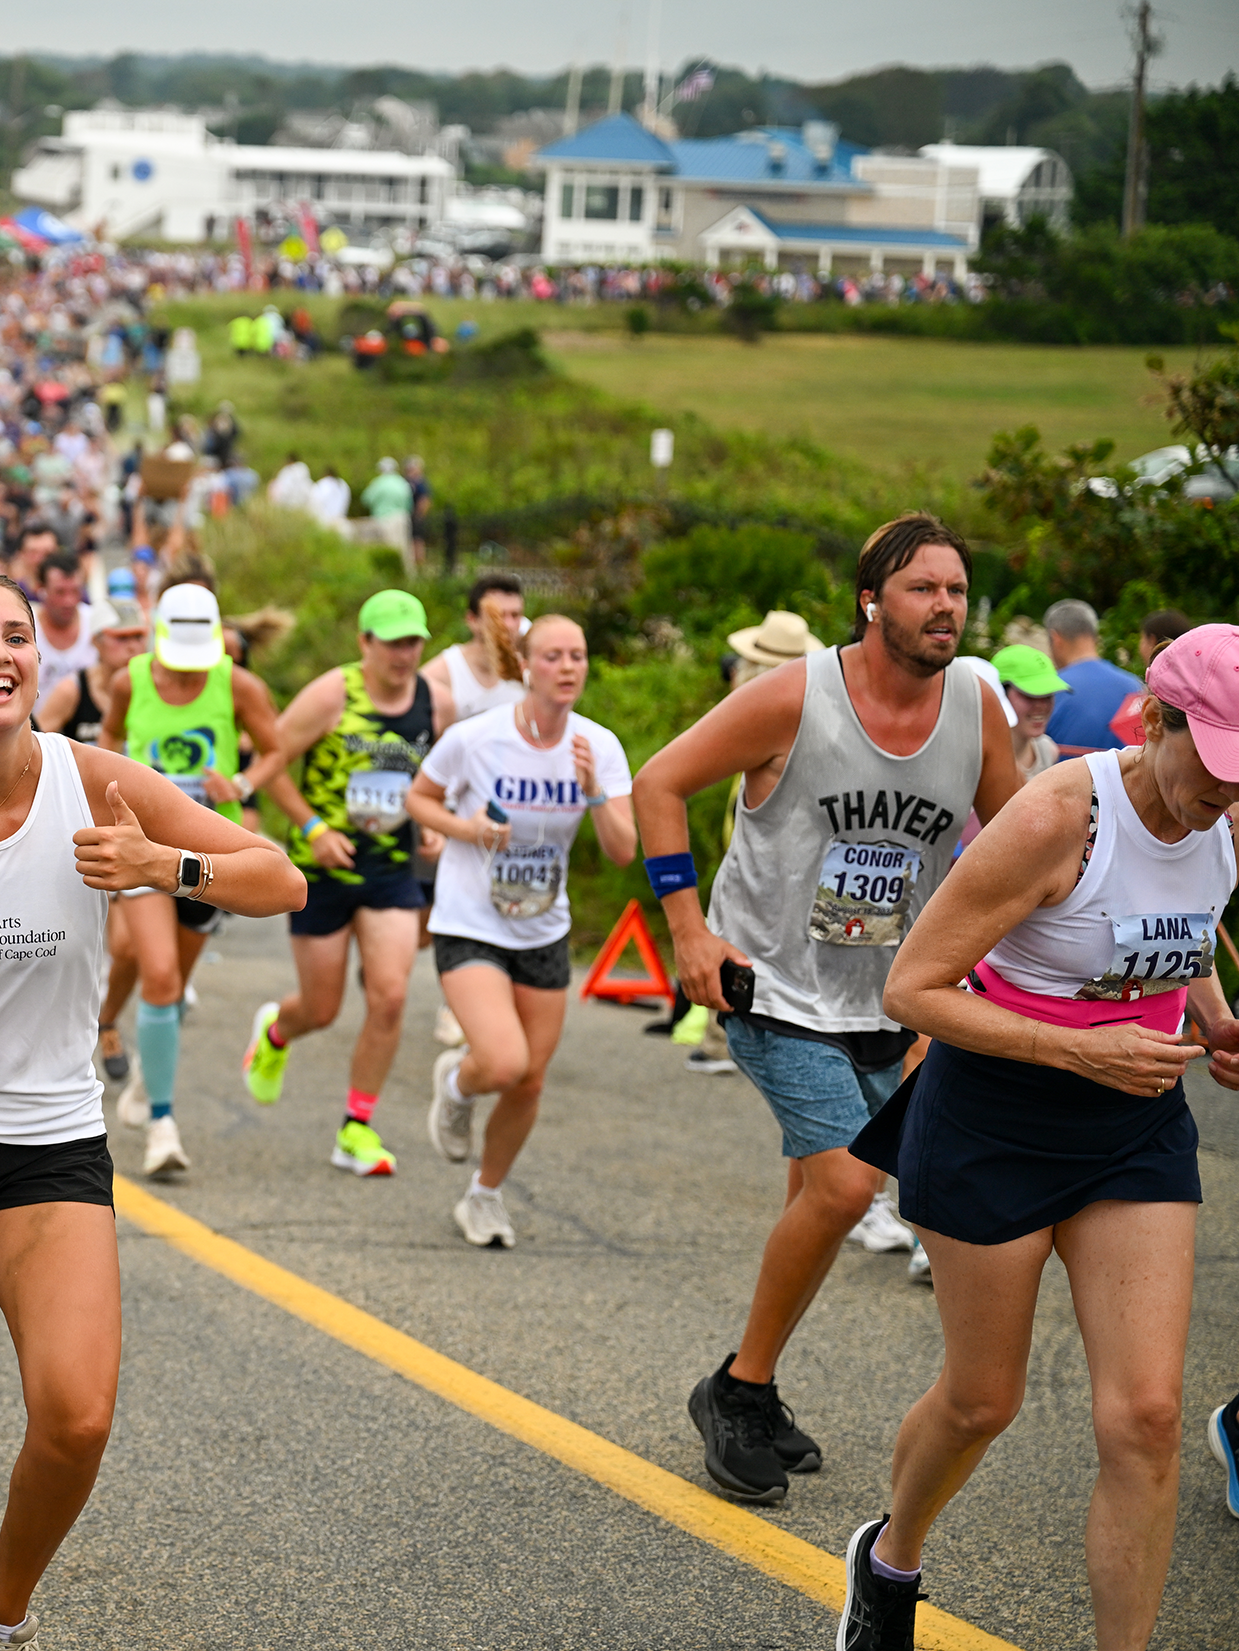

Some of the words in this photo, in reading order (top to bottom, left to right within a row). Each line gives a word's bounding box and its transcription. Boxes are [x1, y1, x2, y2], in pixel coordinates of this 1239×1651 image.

[818, 789, 954, 846] THAYER
[844, 847, 905, 868] CONOR
[834, 871, 904, 903] 1309
[1141, 917, 1193, 941] LANA
[4, 949, 33, 962] Cape
[35, 945, 57, 958] Cod
[1119, 950, 1203, 981] 1125
